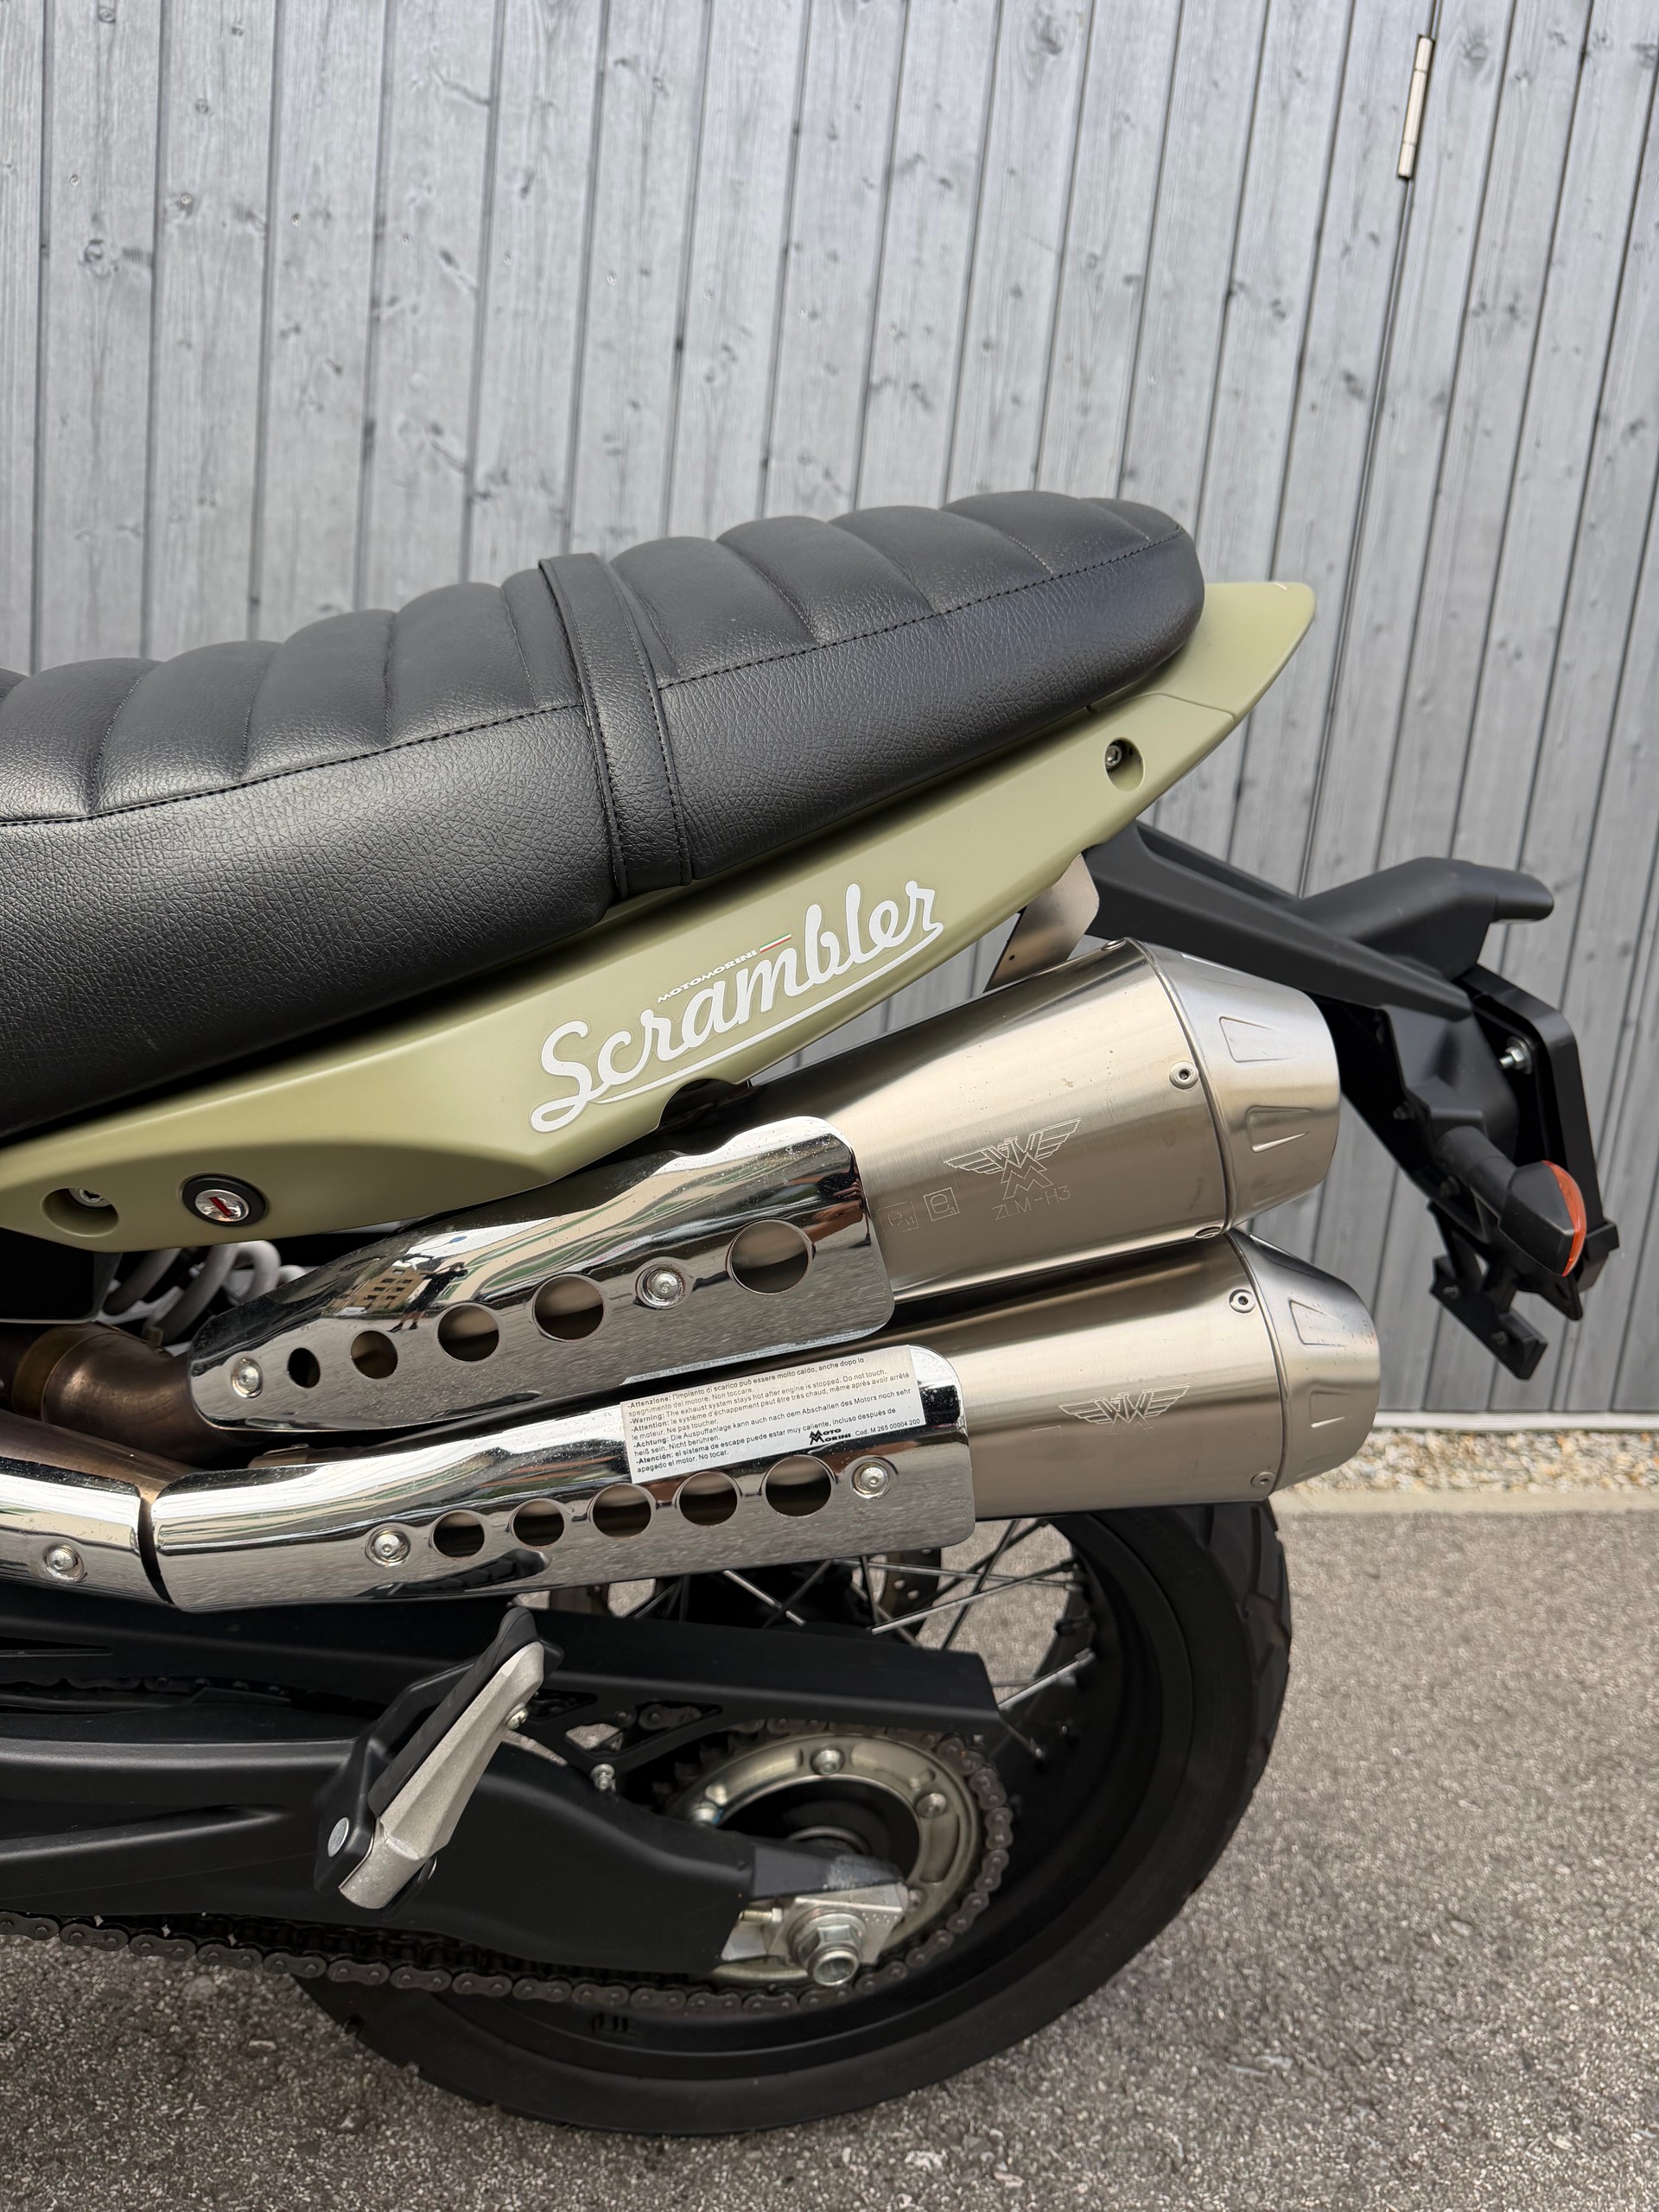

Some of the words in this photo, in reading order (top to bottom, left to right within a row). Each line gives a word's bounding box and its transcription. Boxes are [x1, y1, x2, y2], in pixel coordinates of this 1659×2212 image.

[658, 950, 758, 1003] MOTOMORINI
[530, 880, 944, 1133] Scrambler
[992, 1185, 1071, 1220] ZLM-H3
[629, 1413, 664, 1424] -Warning:
[680, 1404, 708, 1414] exhaust
[708, 1400, 733, 1409] system
[734, 1395, 752, 1404] stays
[765, 1389, 780, 1398] after
[781, 1385, 804, 1395] engine
[812, 1377, 842, 1389] stopped.
[865, 1369, 887, 1378] touch.
[684, 1396, 710, 1405] motore.
[727, 1388, 753, 1397] toccare.
[713, 1382, 738, 1392] scarico
[739, 1378, 752, 1388] può
[753, 1375, 776, 1384] essere
[777, 1370, 796, 1379] molto
[796, 1367, 817, 1376] caldo,
[818, 1363, 839, 1371] anche
[631, 1421, 670, 1433] -Attention:
[678, 1413, 707, 1424] système
[760, 1398, 776, 1408] peut
[805, 1388, 829, 1397] chaud,
[830, 1384, 850, 1393] même
[851, 1380, 870, 1389] après
[871, 1376, 888, 1384] avoir
[633, 1437, 669, 1448] -Achtung:
[750, 1416, 767, 1425] auch
[768, 1413, 785, 1421] nach
[802, 1402, 840, 1414] Abschalten
[854, 1395, 877, 1404] Motors
[878, 1391, 895, 1400] noch
[895, 1388, 911, 1396] sehr
[639, 1429, 665, 1440] moteur.
[677, 1424, 690, 1433] pas
[690, 1419, 719, 1428] toucher.
[668, 1440, 687, 1450] Nicht
[687, 1435, 721, 1446] berühren.
[682, 1446, 709, 1455] sistema
[720, 1438, 745, 1448] escape
[746, 1433, 767, 1444] puede
[768, 1429, 785, 1438] estar
[832, 1415, 856, 1425] incluso
[857, 1409, 887, 1421] después
[637, 1462, 667, 1473] apagado
[676, 1456, 697, 1465] motor.
[709, 1450, 729, 1459] tocar.
